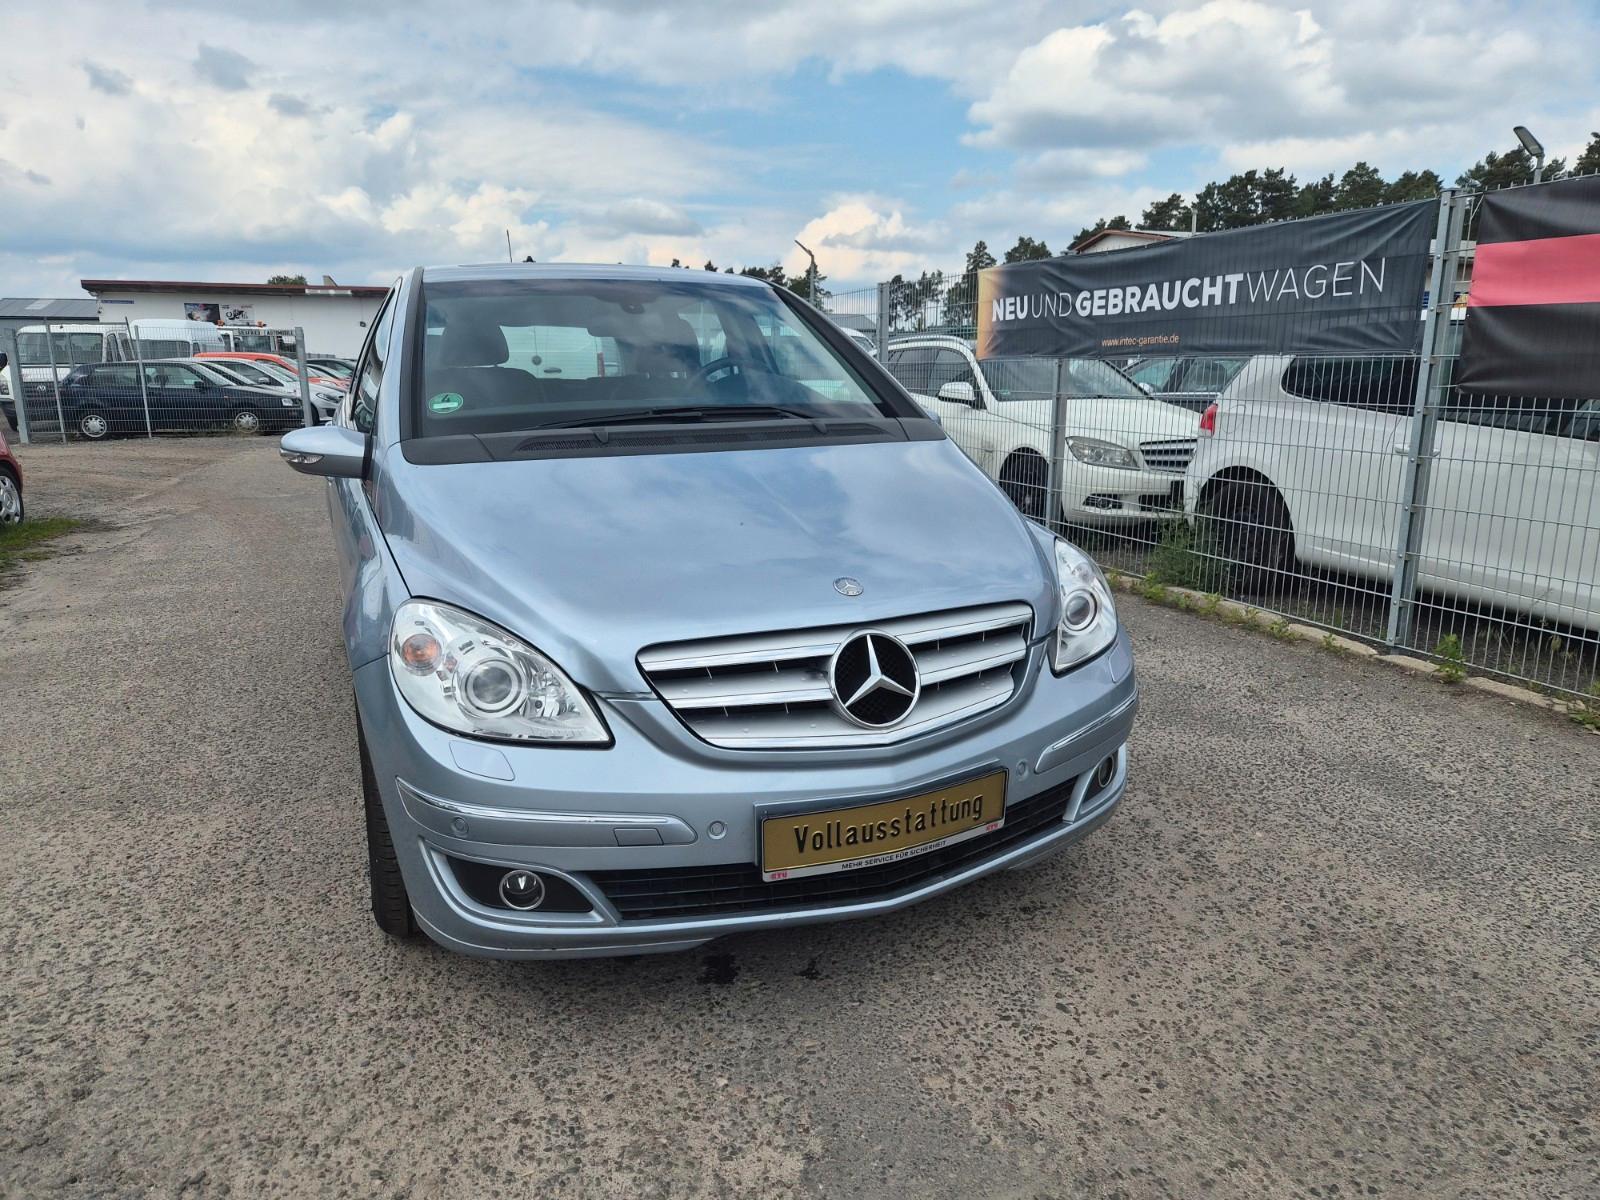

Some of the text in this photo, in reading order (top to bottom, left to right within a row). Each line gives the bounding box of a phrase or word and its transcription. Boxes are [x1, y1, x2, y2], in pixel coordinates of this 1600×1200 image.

[1101, 333, 1180, 347] www.intec-garantie.de
[793, 794, 984, 854] Vollausstattung
[841, 840, 947, 870] MEHR SERVICE FÜR SICHERHEIT
